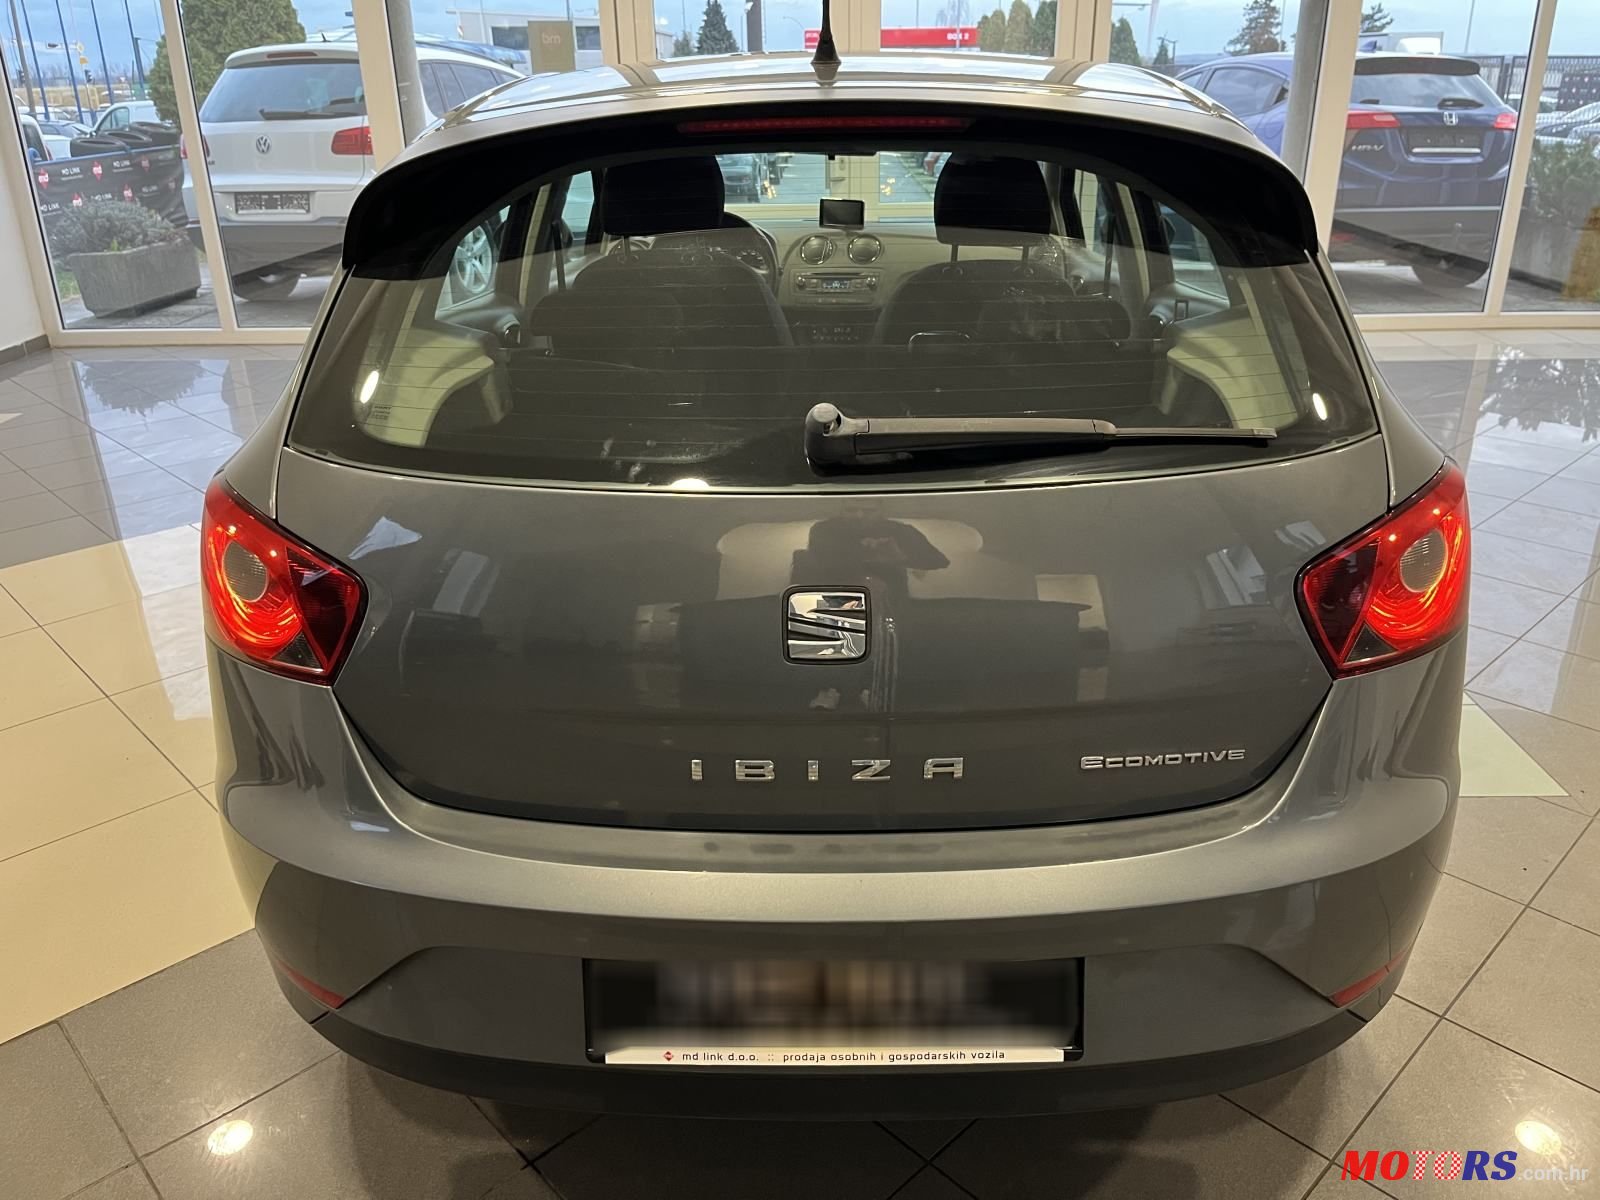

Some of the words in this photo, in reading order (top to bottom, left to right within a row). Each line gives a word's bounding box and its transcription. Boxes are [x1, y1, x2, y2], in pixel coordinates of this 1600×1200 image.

[691, 757, 963, 781] IBIZA
[1080, 749, 1246, 769] ECOMOTIVE
[682, 1052, 699, 1061] md
[703, 1052, 723, 1061] link
[727, 1052, 759, 1061] d.o.o.
[783, 1052, 826, 1063] prodaja
[830, 1052, 876, 1061] osobnih
[888, 1051, 966, 1063] gospodarskih
[970, 1050, 1005, 1059] vozila
